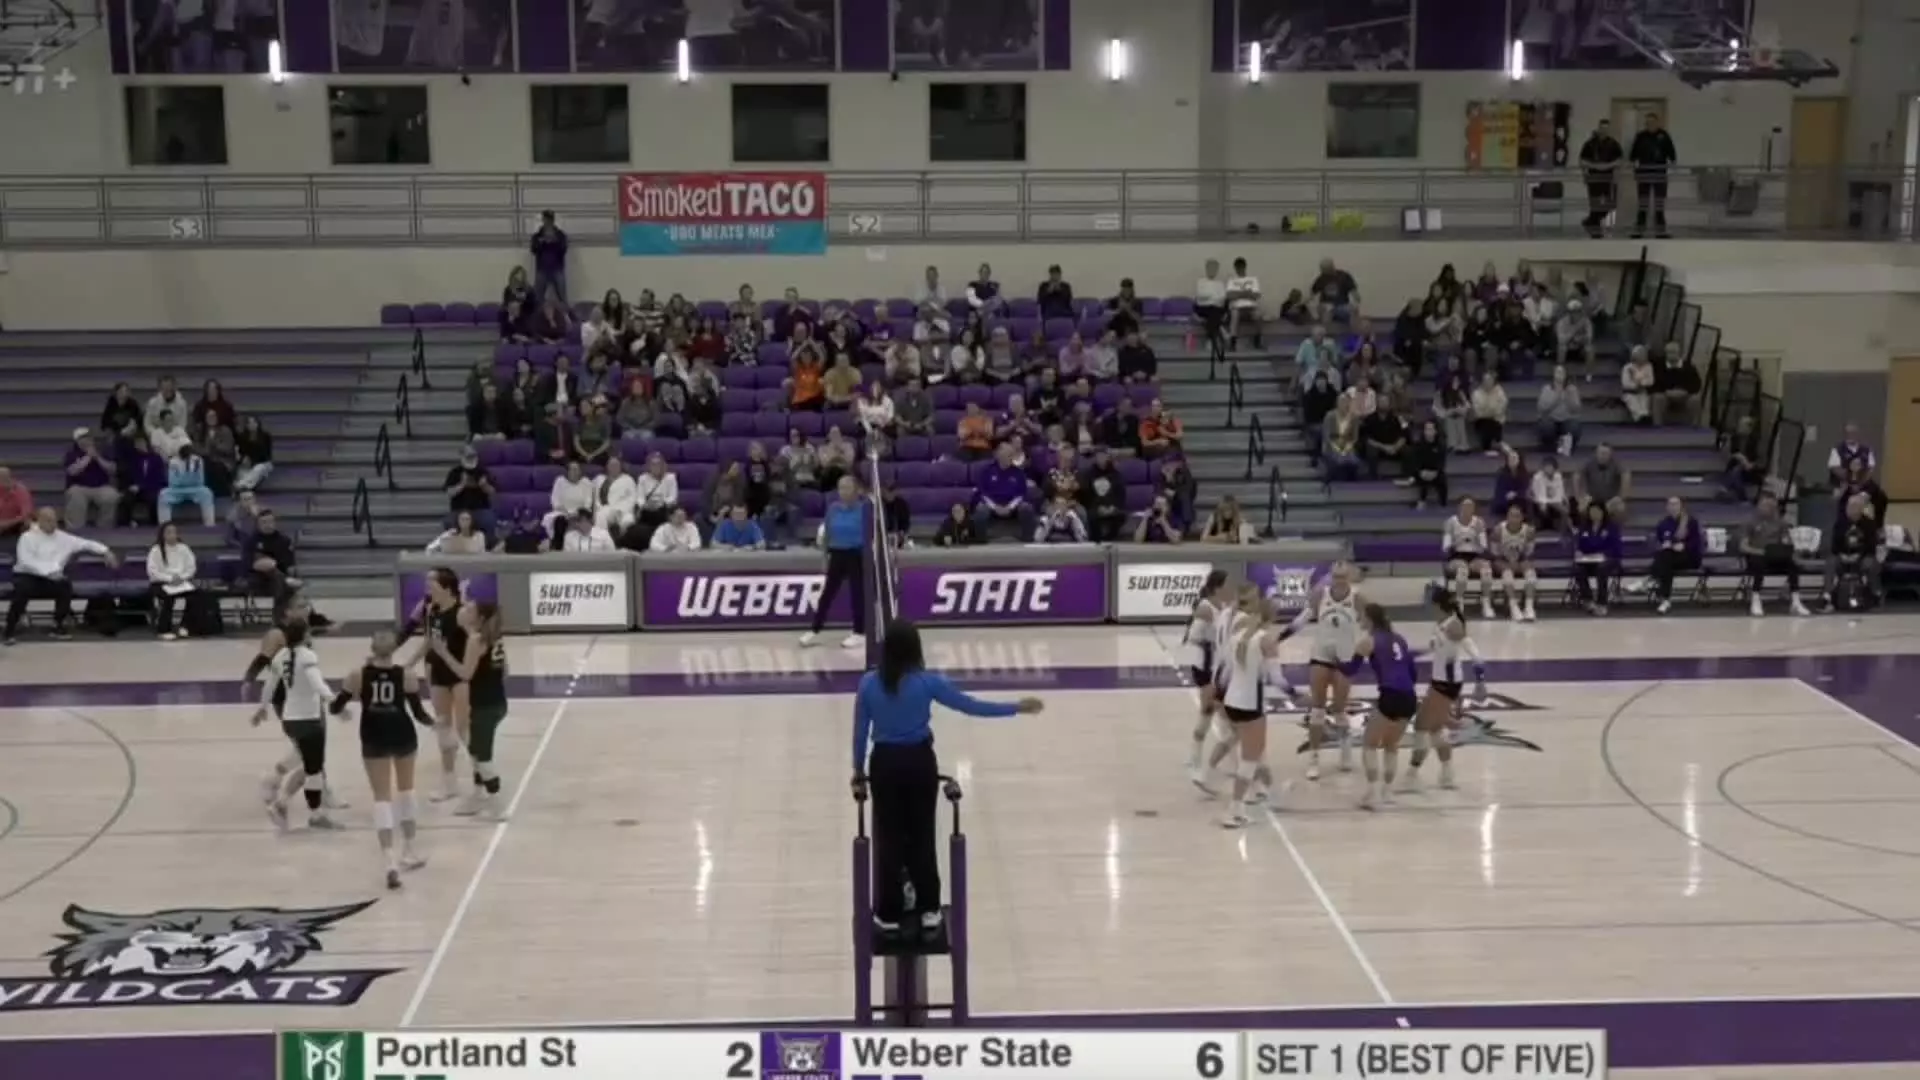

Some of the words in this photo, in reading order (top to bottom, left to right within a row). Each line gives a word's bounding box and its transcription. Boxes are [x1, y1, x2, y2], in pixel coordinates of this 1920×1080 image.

[627, 180, 722, 217] Smoked
[723, 181, 815, 217] TACO
[851, 215, 878, 233] S2
[540, 583, 615, 599] SWENSON
[931, 571, 1057, 613] STATE
[1127, 575, 1203, 590] SWENSON
[677, 574, 826, 617] WEBER
[536, 601, 572, 616] GYM
[370, 680, 395, 705] 10
